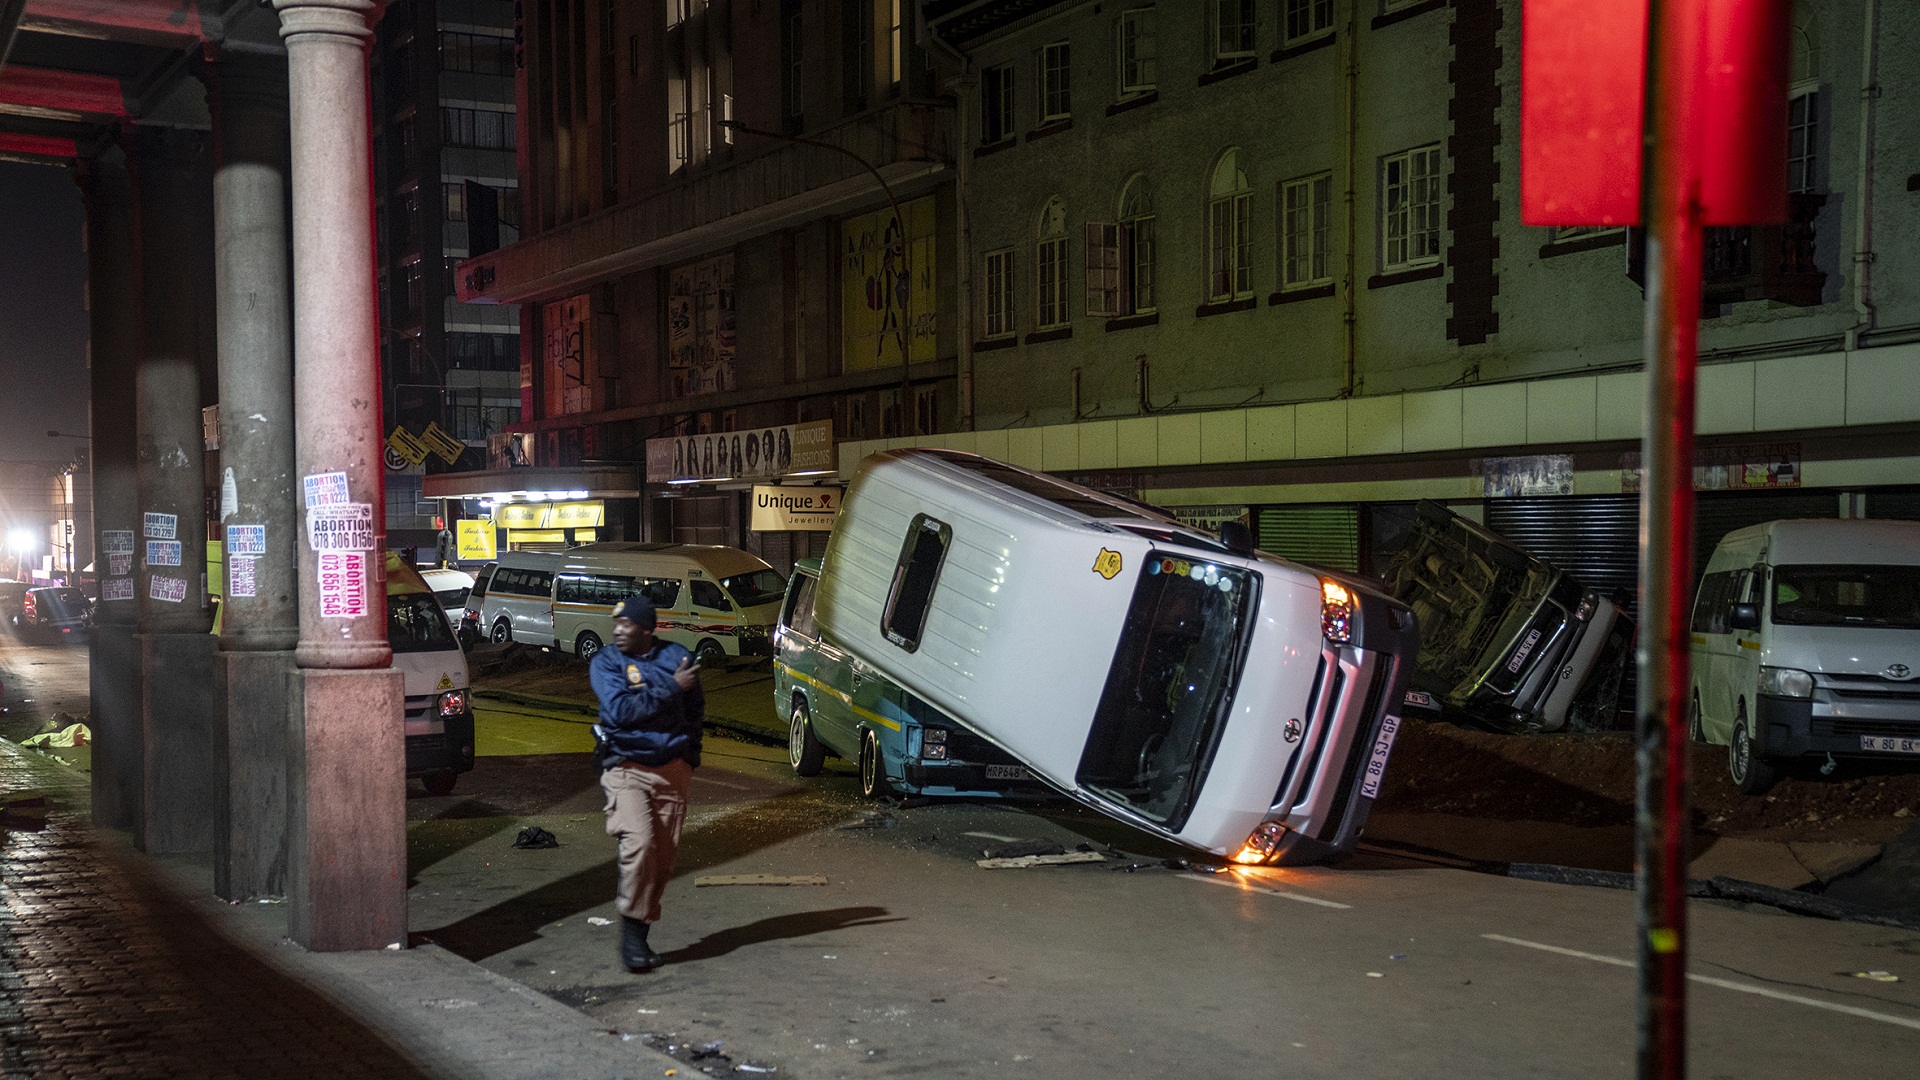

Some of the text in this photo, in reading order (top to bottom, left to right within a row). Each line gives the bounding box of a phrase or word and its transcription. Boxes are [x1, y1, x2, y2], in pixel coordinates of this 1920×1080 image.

[796, 428, 826, 444] UNIQUE
[1742, 444, 1798, 458] CURTAINS
[793, 450, 830, 466] FASHIONS
[306, 475, 344, 487] ABORTION
[307, 492, 347, 507] 078 076 0222
[758, 494, 812, 513] Unique
[146, 515, 175, 525] ABORTION
[314, 519, 371, 532] ABORTION
[788, 517, 834, 525] Jewellery
[161, 529, 174, 538] 2797
[314, 531, 372, 549] 078 306 0156
[238, 543, 247, 552] 076
[249, 543, 263, 551] 0222
[167, 556, 179, 564] 0222
[154, 575, 186, 586] ABORTION
[322, 555, 340, 615] 073 856 1548
[346, 555, 361, 614] ABORTION
[1510, 661, 1518, 671] GP
[1863, 738, 1875, 748] HK
[1883, 740, 1894, 749] 80
[1363, 718, 1397, 795] KL 88 SJ GP
